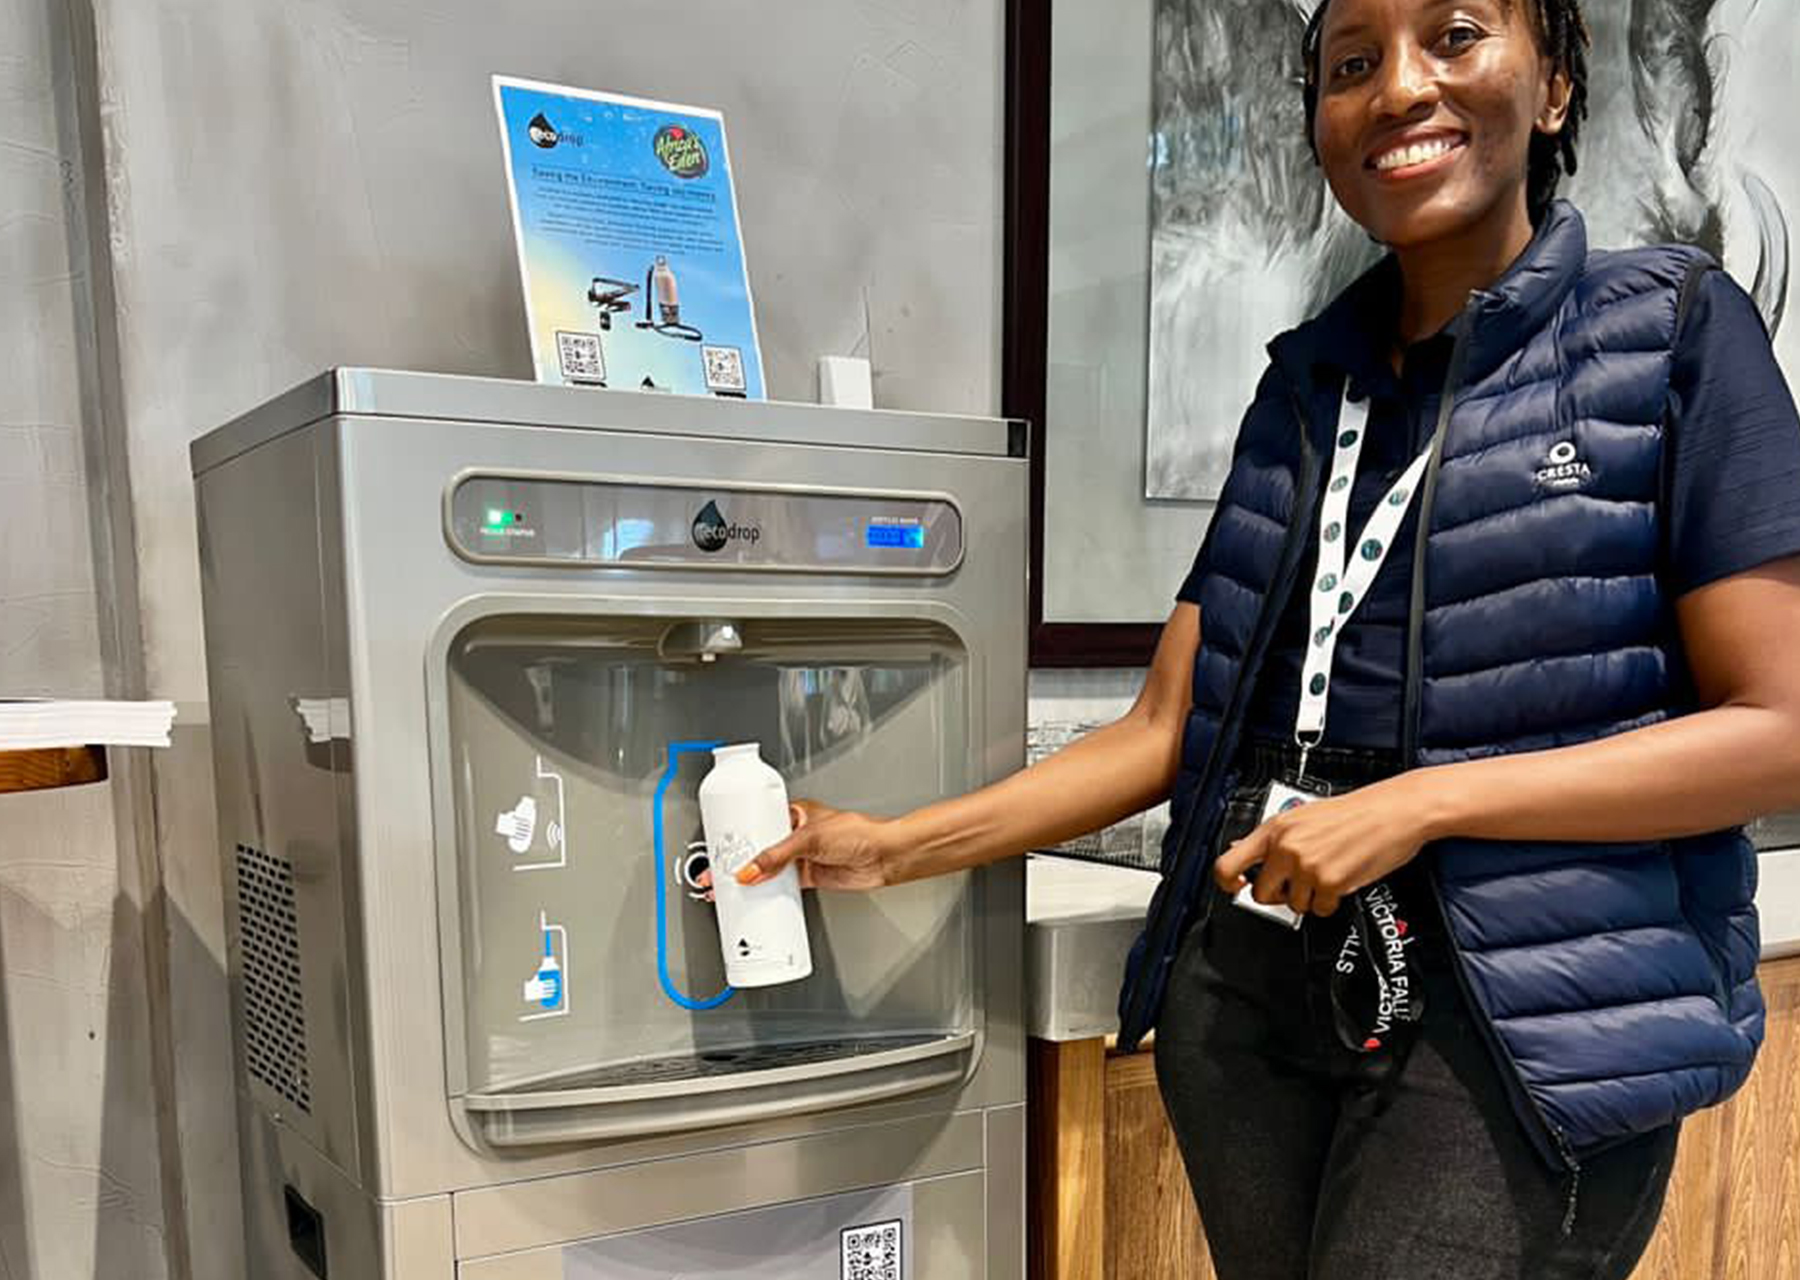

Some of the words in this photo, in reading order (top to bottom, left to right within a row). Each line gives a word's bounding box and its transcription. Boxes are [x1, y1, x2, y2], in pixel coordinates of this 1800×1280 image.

[668, 149, 700, 171] Eden
[1536, 462, 1592, 481] CRESTA
[1364, 887, 1406, 973] VICTORIA
